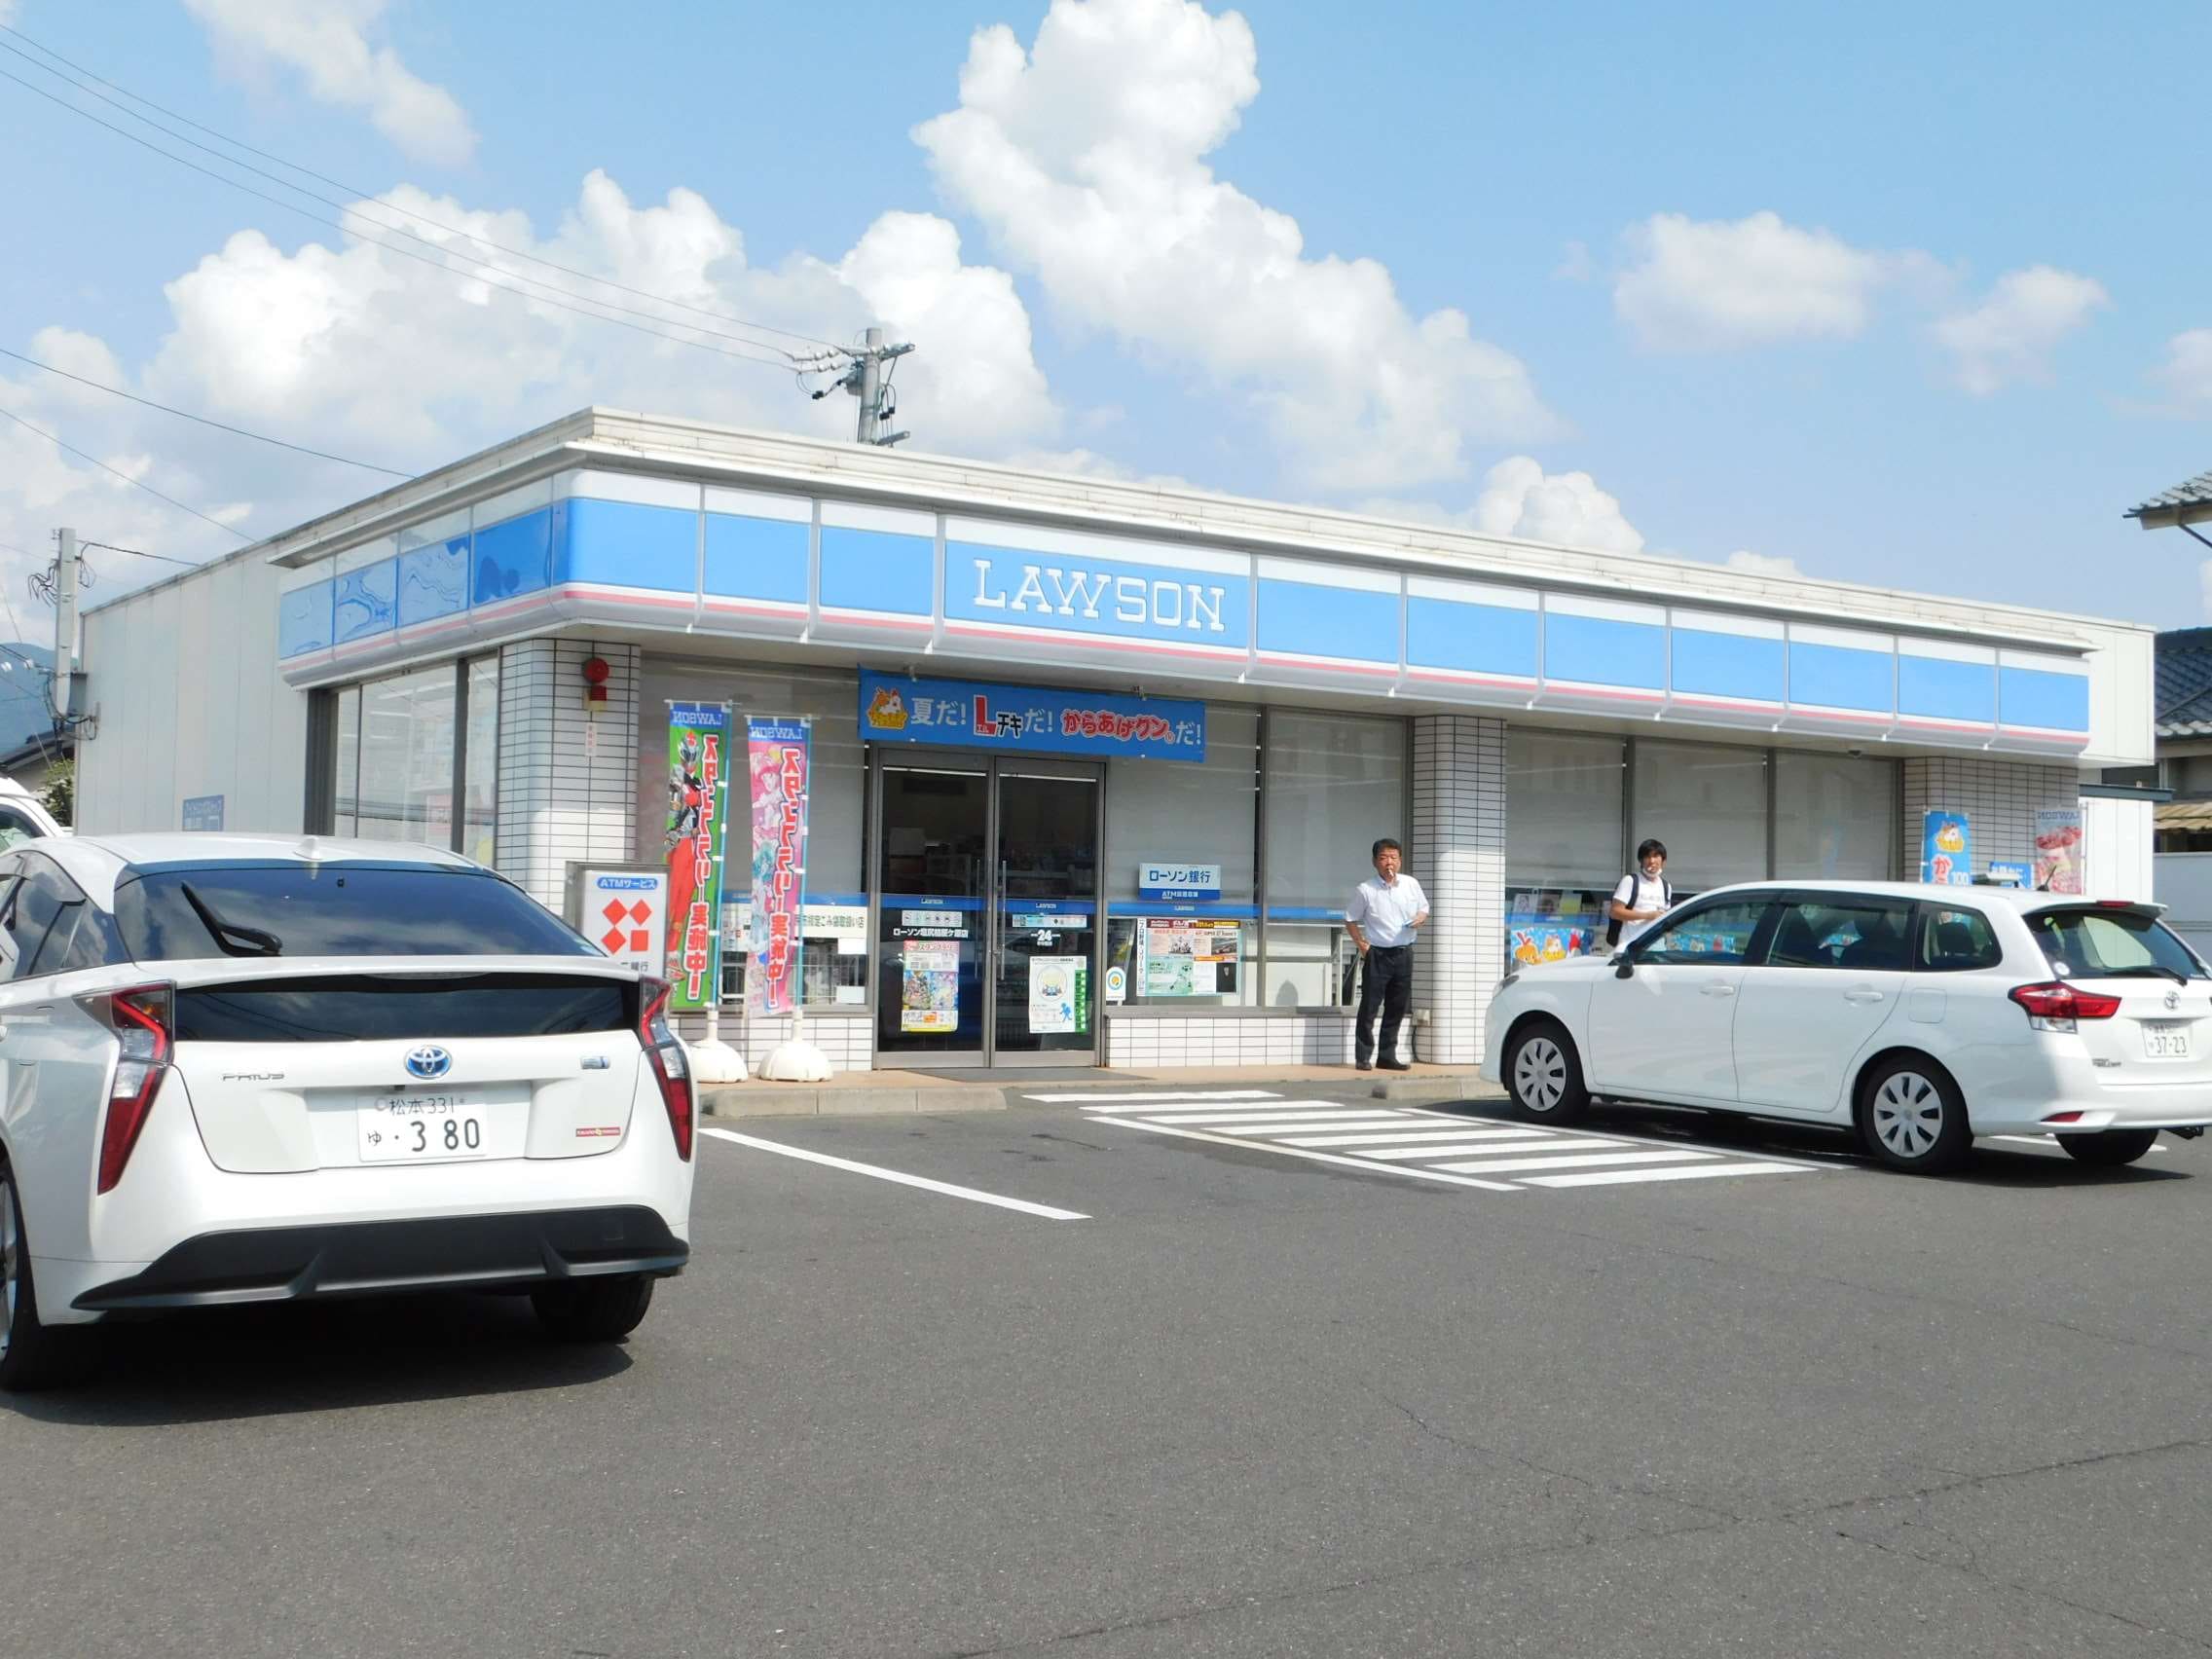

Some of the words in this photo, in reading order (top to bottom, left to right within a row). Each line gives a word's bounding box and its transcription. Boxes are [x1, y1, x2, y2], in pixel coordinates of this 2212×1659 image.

[974, 559, 1226, 632] LAWSON
[1149, 869, 1211, 883] ローソン銀行
[600, 878, 655, 889] ATMサービス
[1037, 929, 1052, 941] 24
